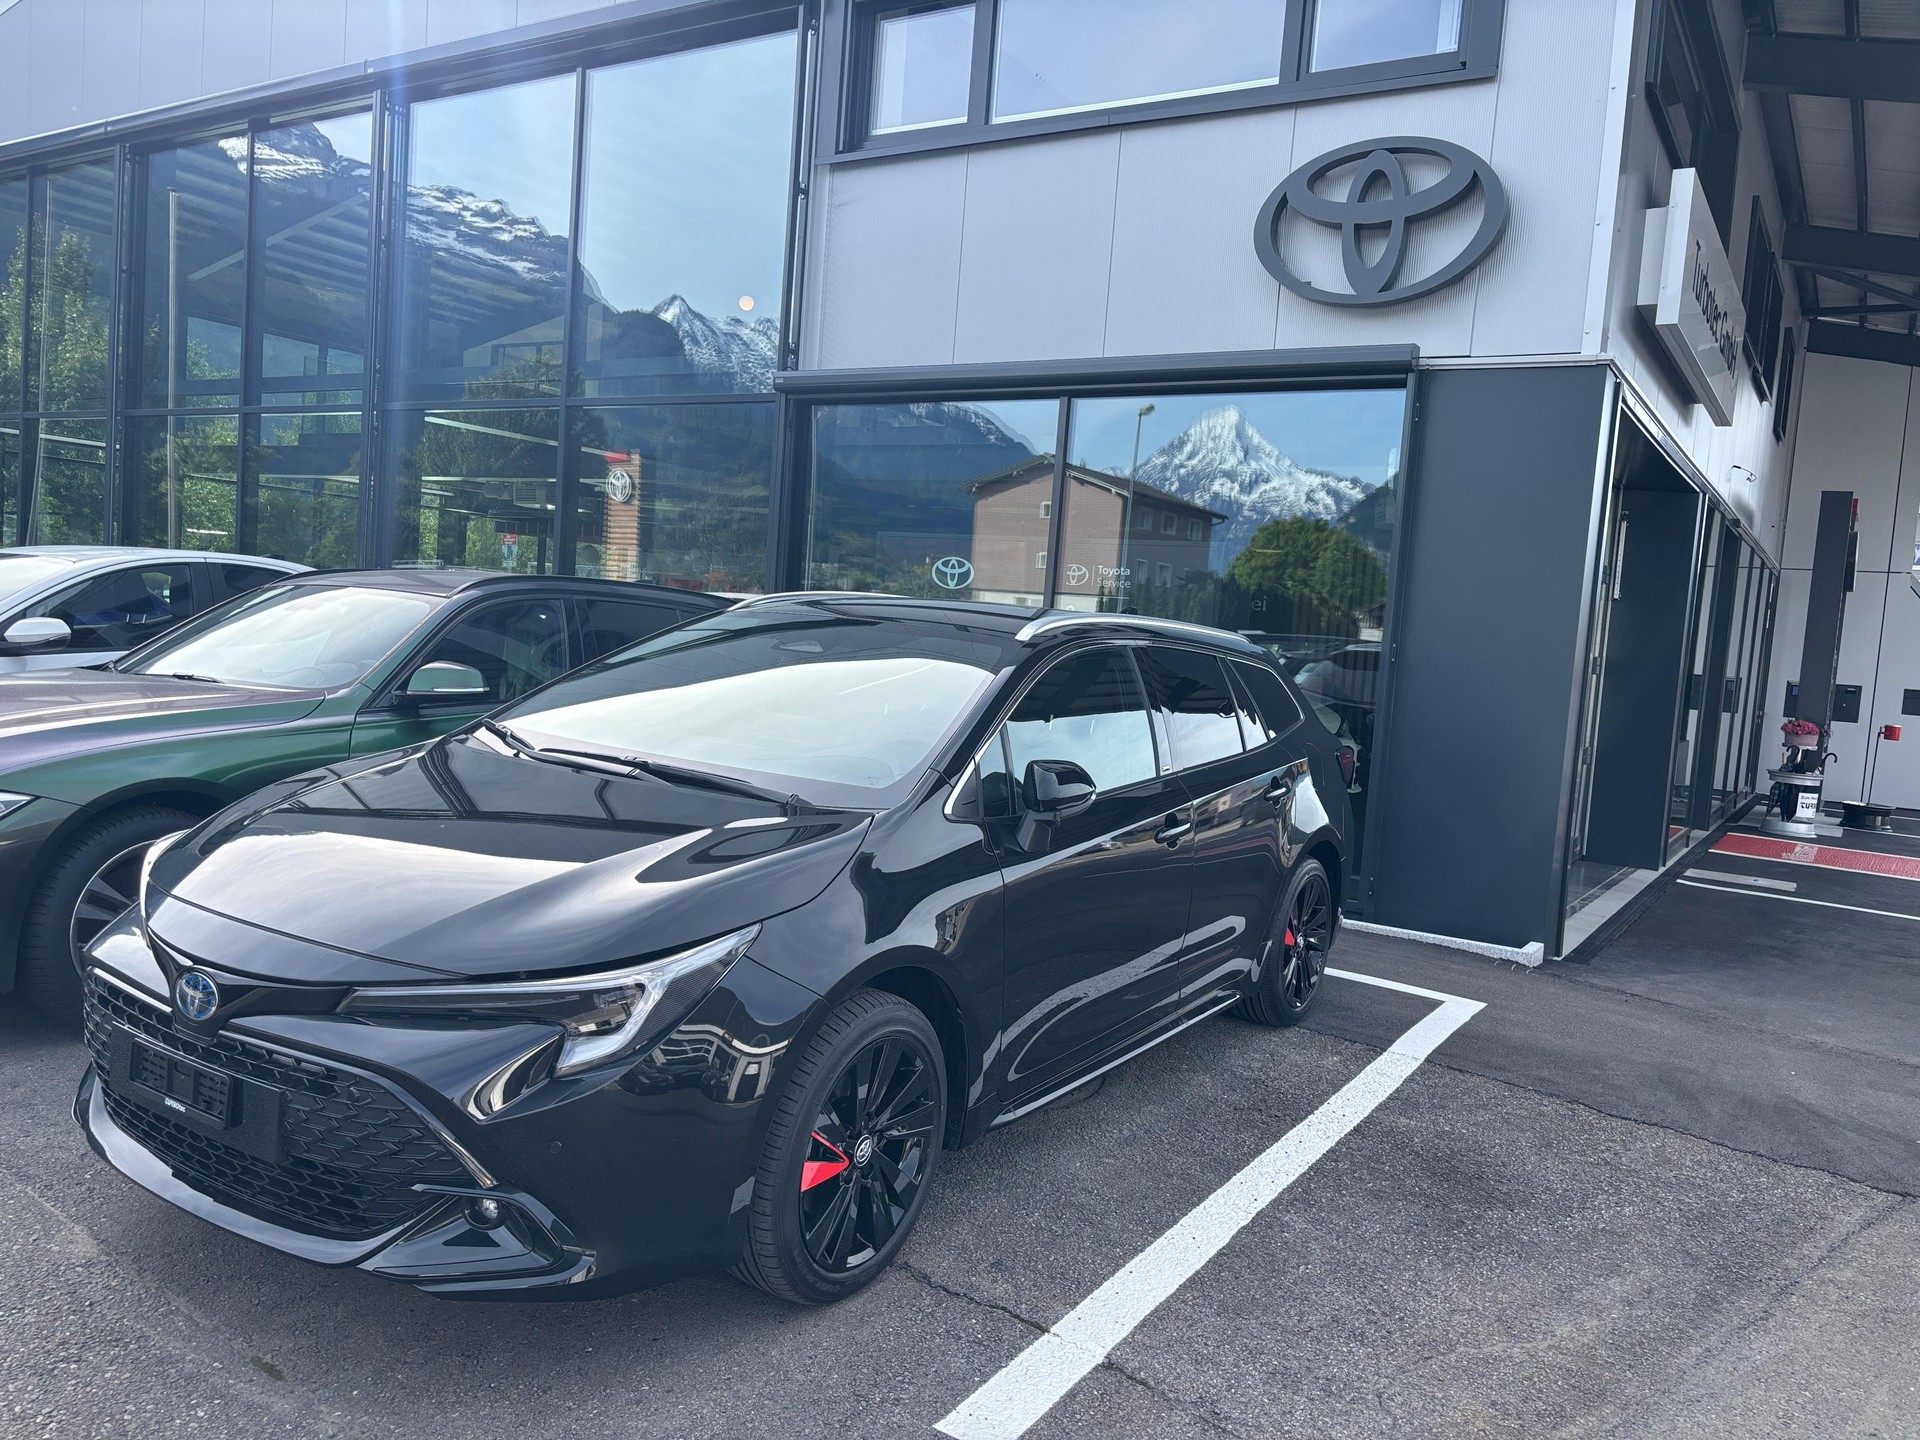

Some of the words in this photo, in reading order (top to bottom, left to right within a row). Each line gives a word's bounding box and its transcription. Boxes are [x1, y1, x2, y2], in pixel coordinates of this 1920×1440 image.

[1692, 238, 1721, 343] Turbotec
[1720, 310, 1738, 380] GmbH
[1097, 565, 1130, 577] Toyota
[1096, 577, 1130, 588] Service
